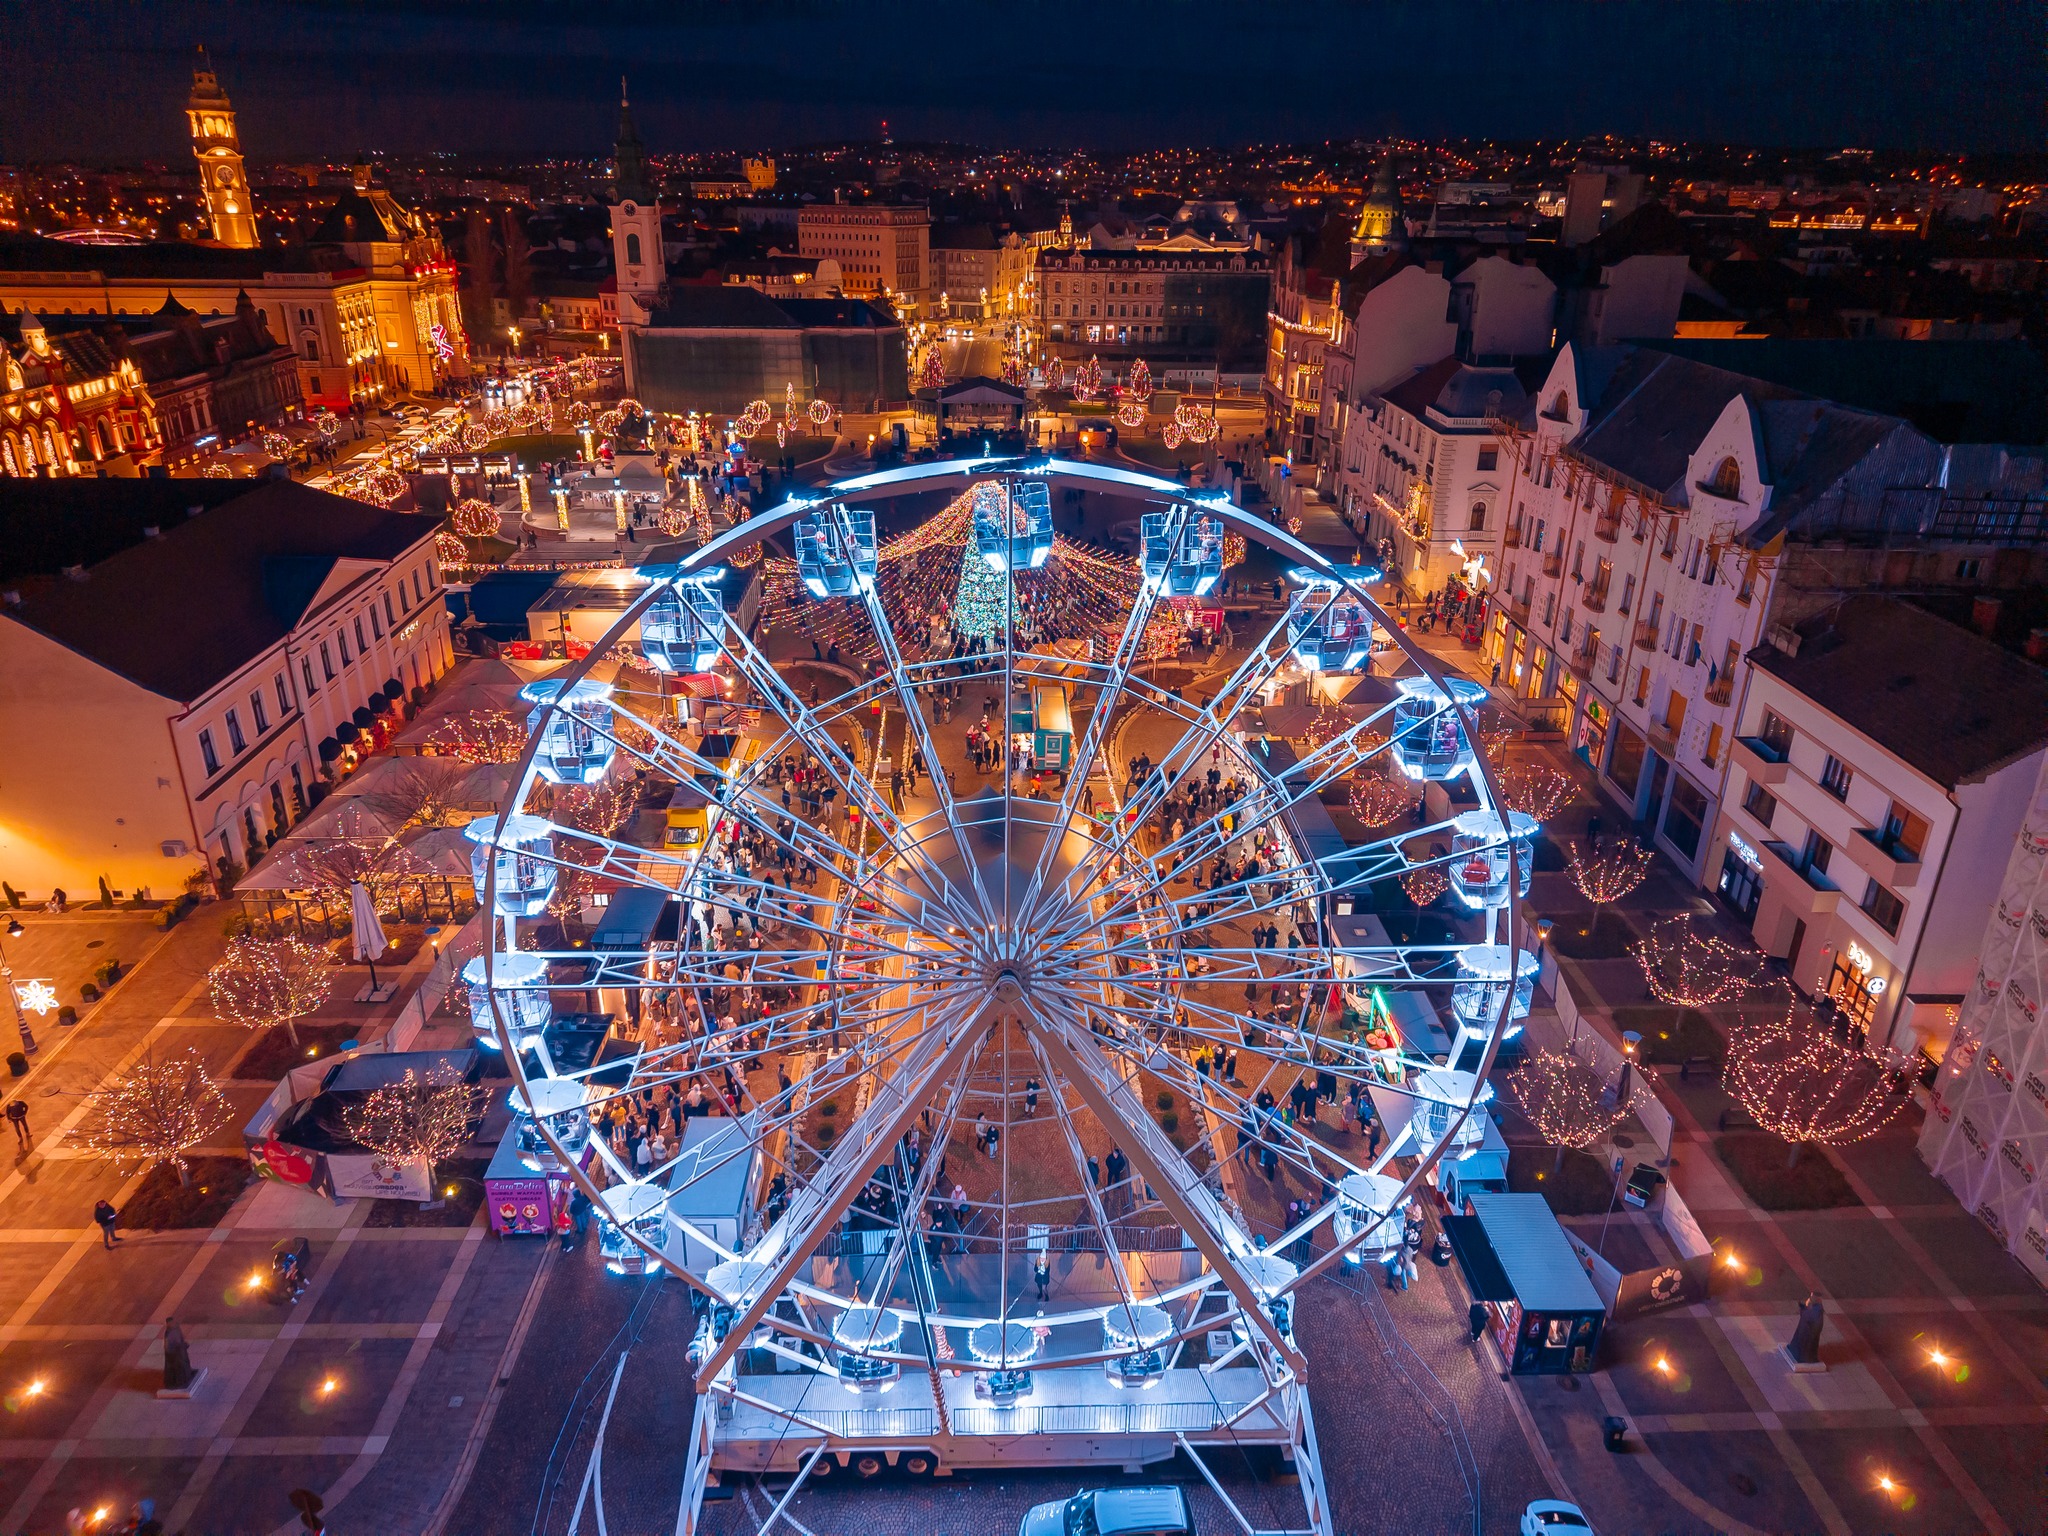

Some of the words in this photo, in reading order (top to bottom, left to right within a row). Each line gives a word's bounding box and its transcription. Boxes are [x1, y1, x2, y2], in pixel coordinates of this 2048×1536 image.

[2027, 1071, 2046, 1093] san
[1962, 1115, 1979, 1138] san
[1960, 1123, 1987, 1161] marco
[2004, 1139, 2023, 1160] san
[2001, 1146, 2032, 1184] marco
[2027, 1226, 2047, 1247] san
